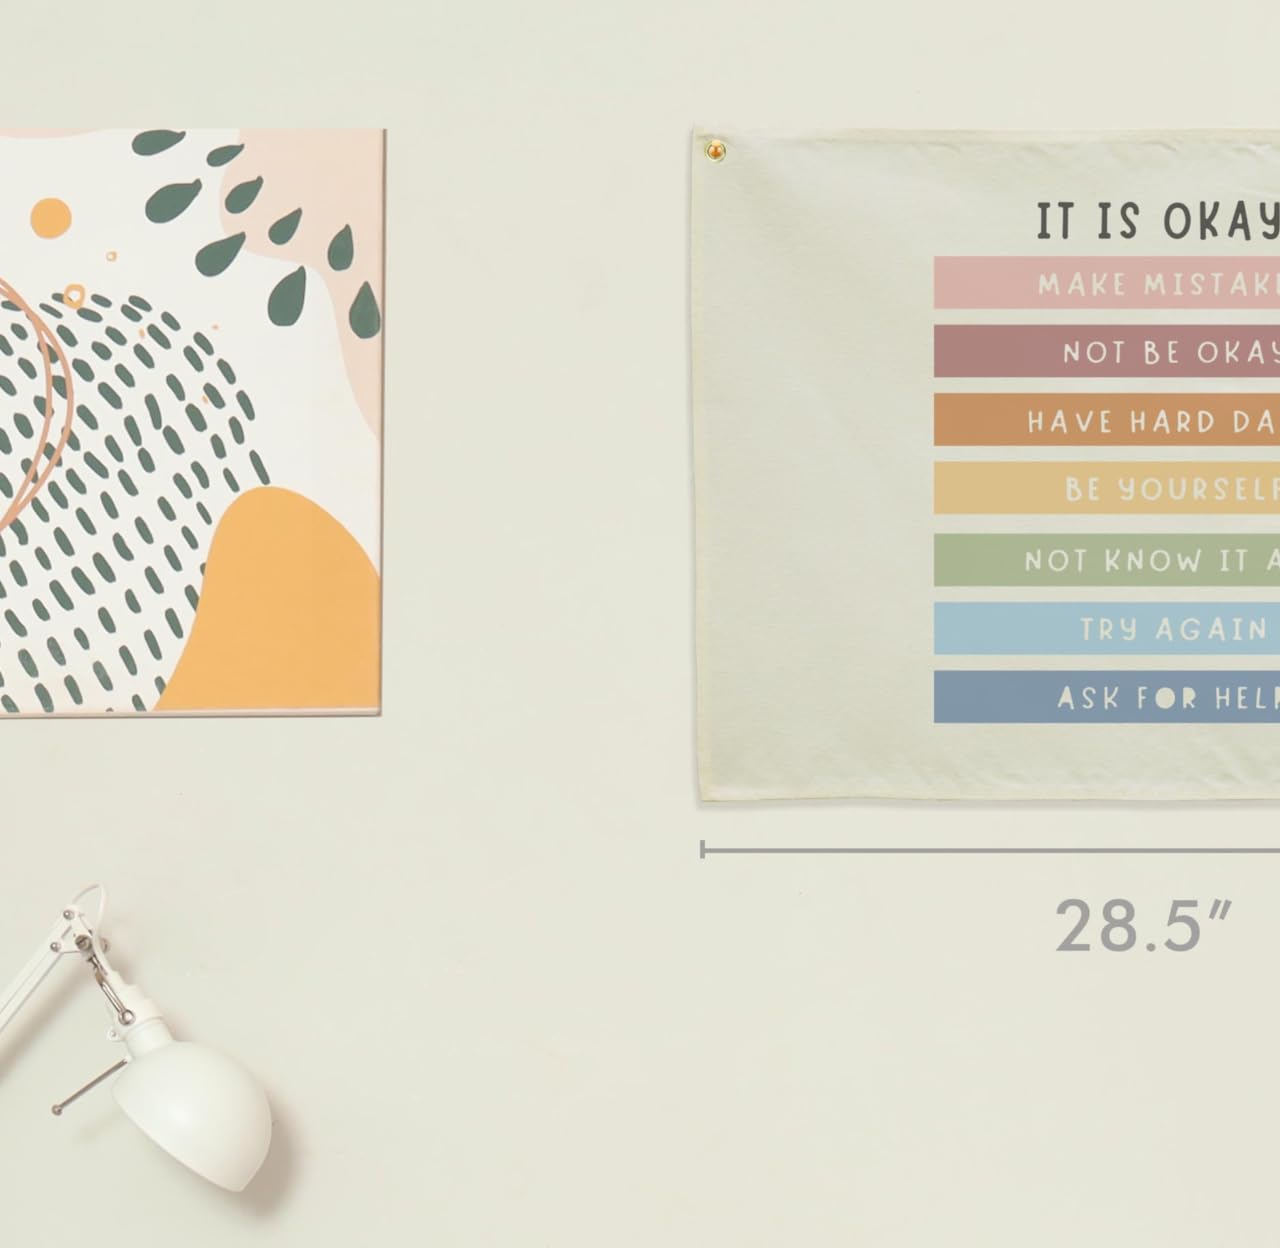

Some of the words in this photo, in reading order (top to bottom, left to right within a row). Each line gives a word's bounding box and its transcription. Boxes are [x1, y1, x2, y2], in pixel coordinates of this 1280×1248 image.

[1036, 201, 1076, 240] IT
[1097, 201, 1141, 240] IS
[1037, 271, 1126, 297] MAKE
[1062, 340, 1126, 364] NOT
[1143, 340, 1180, 365] BE
[1027, 409, 1112, 434] HAVE
[1129, 409, 1215, 434] HARD
[1064, 476, 1100, 502] BE
[1024, 548, 1088, 572] NOT
[1104, 548, 1203, 573] KNOW
[1219, 548, 1249, 572] IT
[1080, 617, 1138, 641] TRY
[1154, 616, 1267, 641] AGAIN
[1056, 685, 1120, 710] ASK
[1136, 686, 1197, 710] FOR
